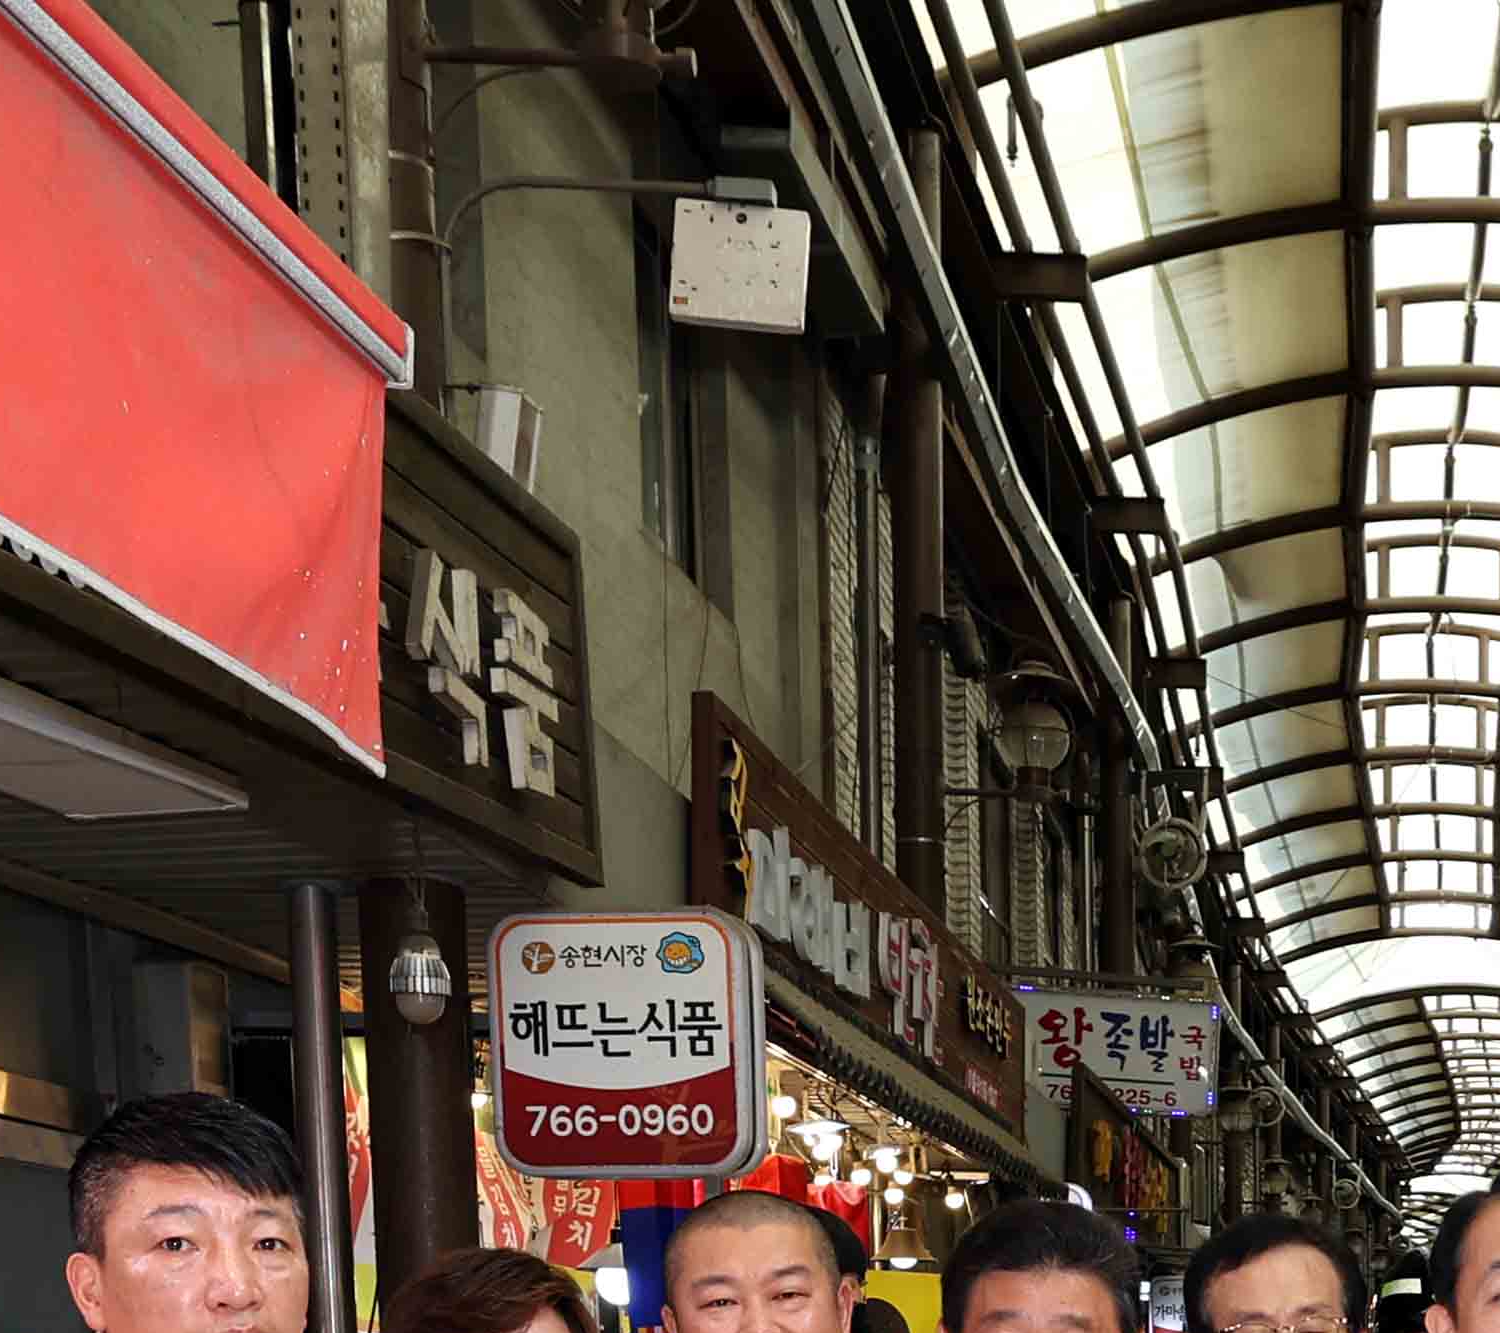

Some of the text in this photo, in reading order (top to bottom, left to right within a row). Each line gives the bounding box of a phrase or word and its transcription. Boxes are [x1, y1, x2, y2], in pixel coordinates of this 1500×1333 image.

[405, 545, 562, 797] 식품
[559, 944, 647, 969] 송현시장
[508, 998, 723, 1058] 해뜨는식품
[1179, 1024, 1209, 1081] 국밥
[524, 1103, 715, 1137] 766-0960
